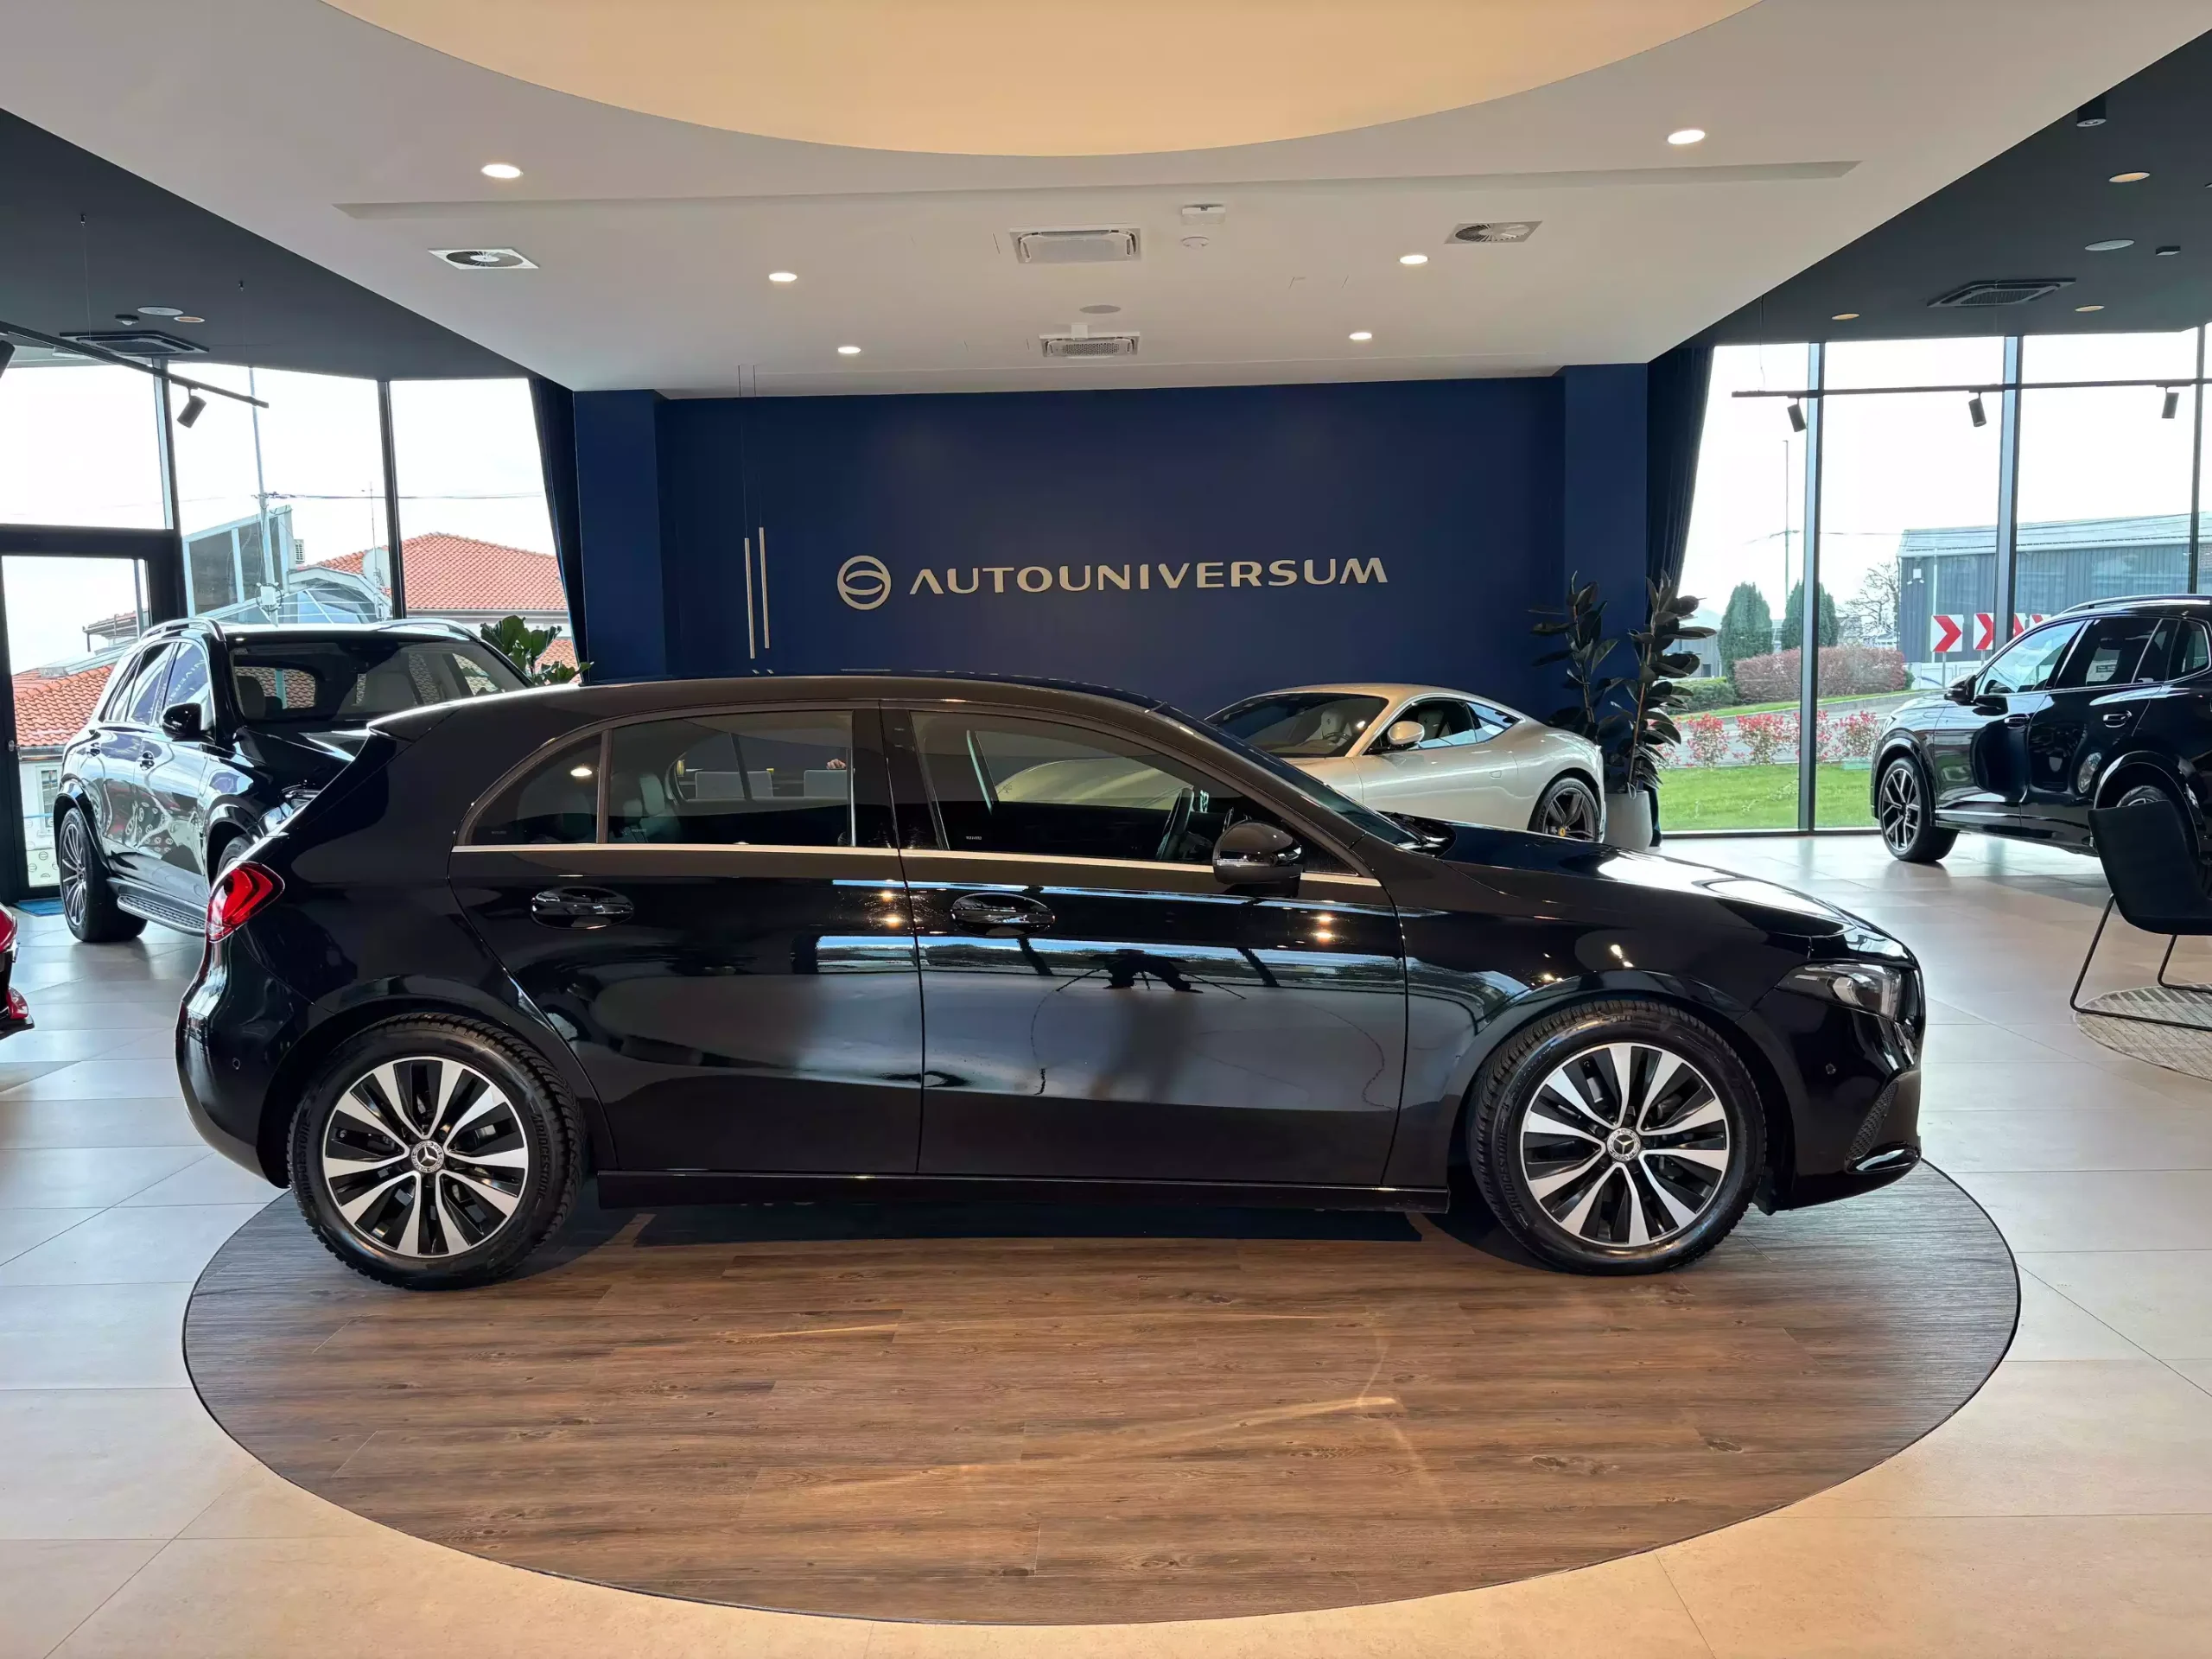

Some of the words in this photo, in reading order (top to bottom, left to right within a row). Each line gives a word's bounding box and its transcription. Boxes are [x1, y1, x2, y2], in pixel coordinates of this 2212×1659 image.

[910, 557, 1388, 594] AUTOUNIVERSUM
[531, 1113, 550, 1199] BRIDGESTONE
[1497, 1128, 1525, 1214] BRIDGESTONE
